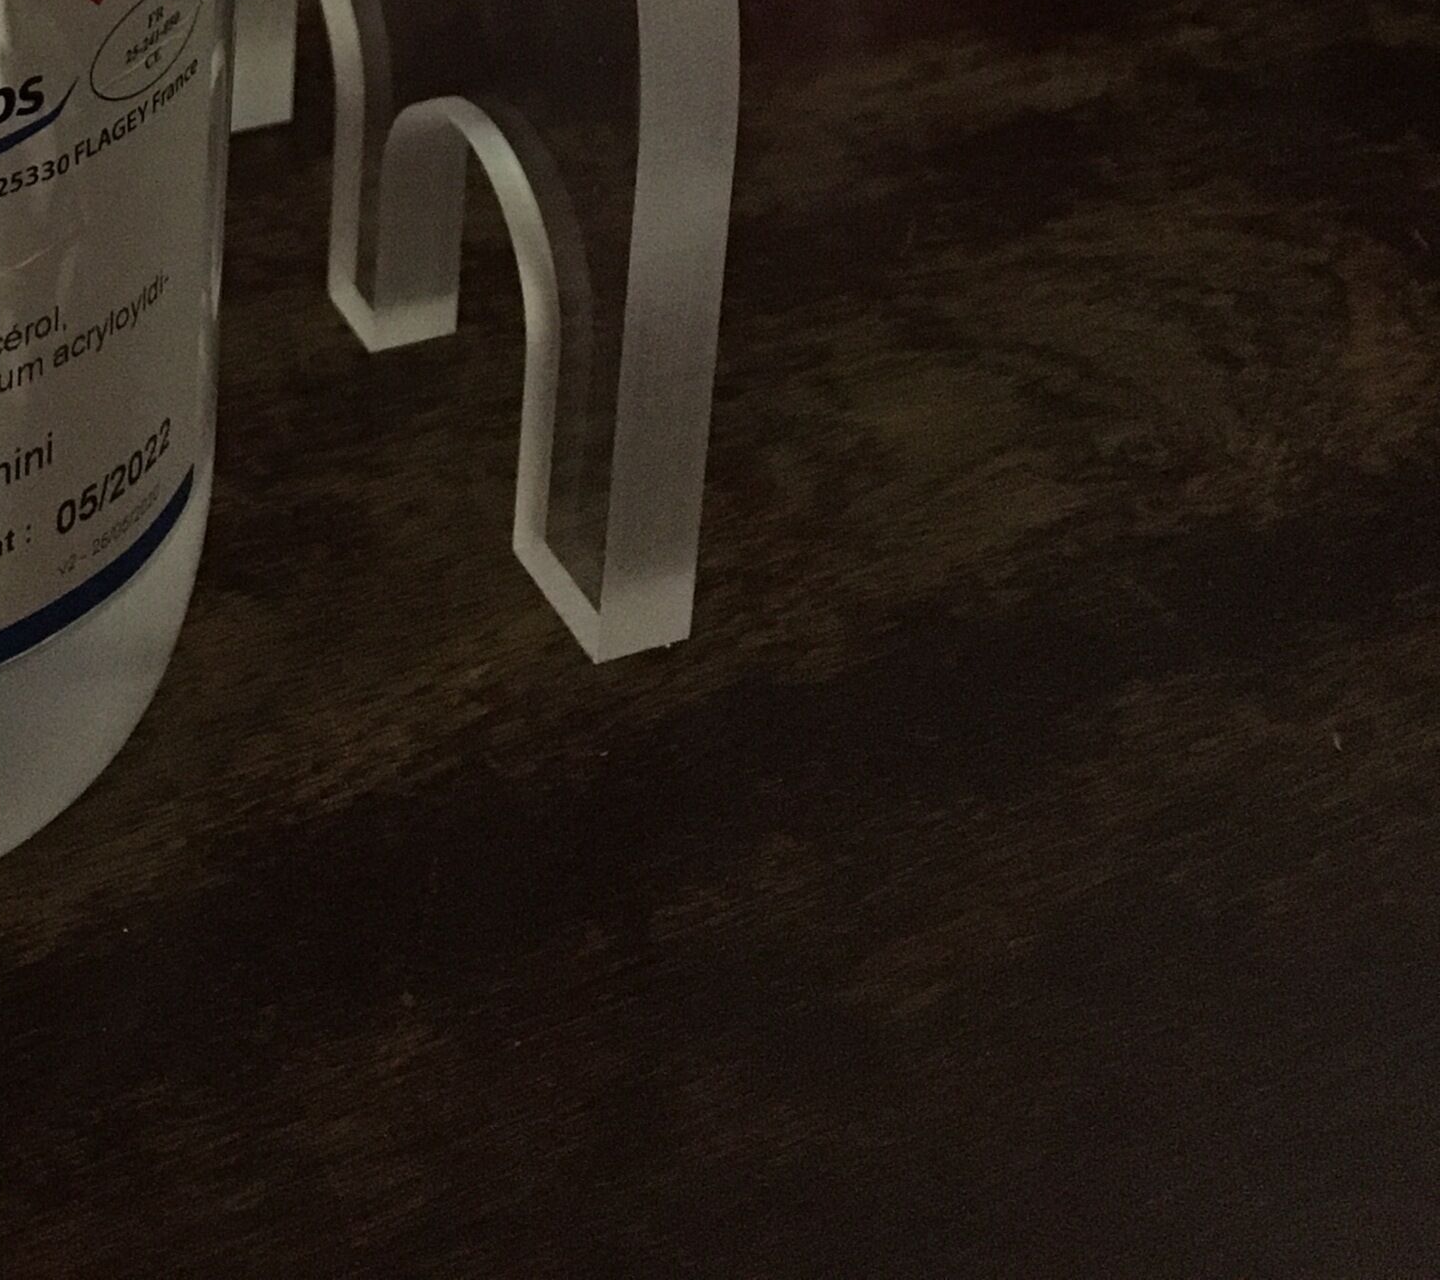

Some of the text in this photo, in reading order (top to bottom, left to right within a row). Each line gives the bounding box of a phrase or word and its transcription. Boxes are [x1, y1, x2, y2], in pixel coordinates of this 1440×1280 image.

[75, 101, 148, 165] FLAGEY
[152, 59, 198, 113] France
[55, 418, 171, 536] 05/2022
